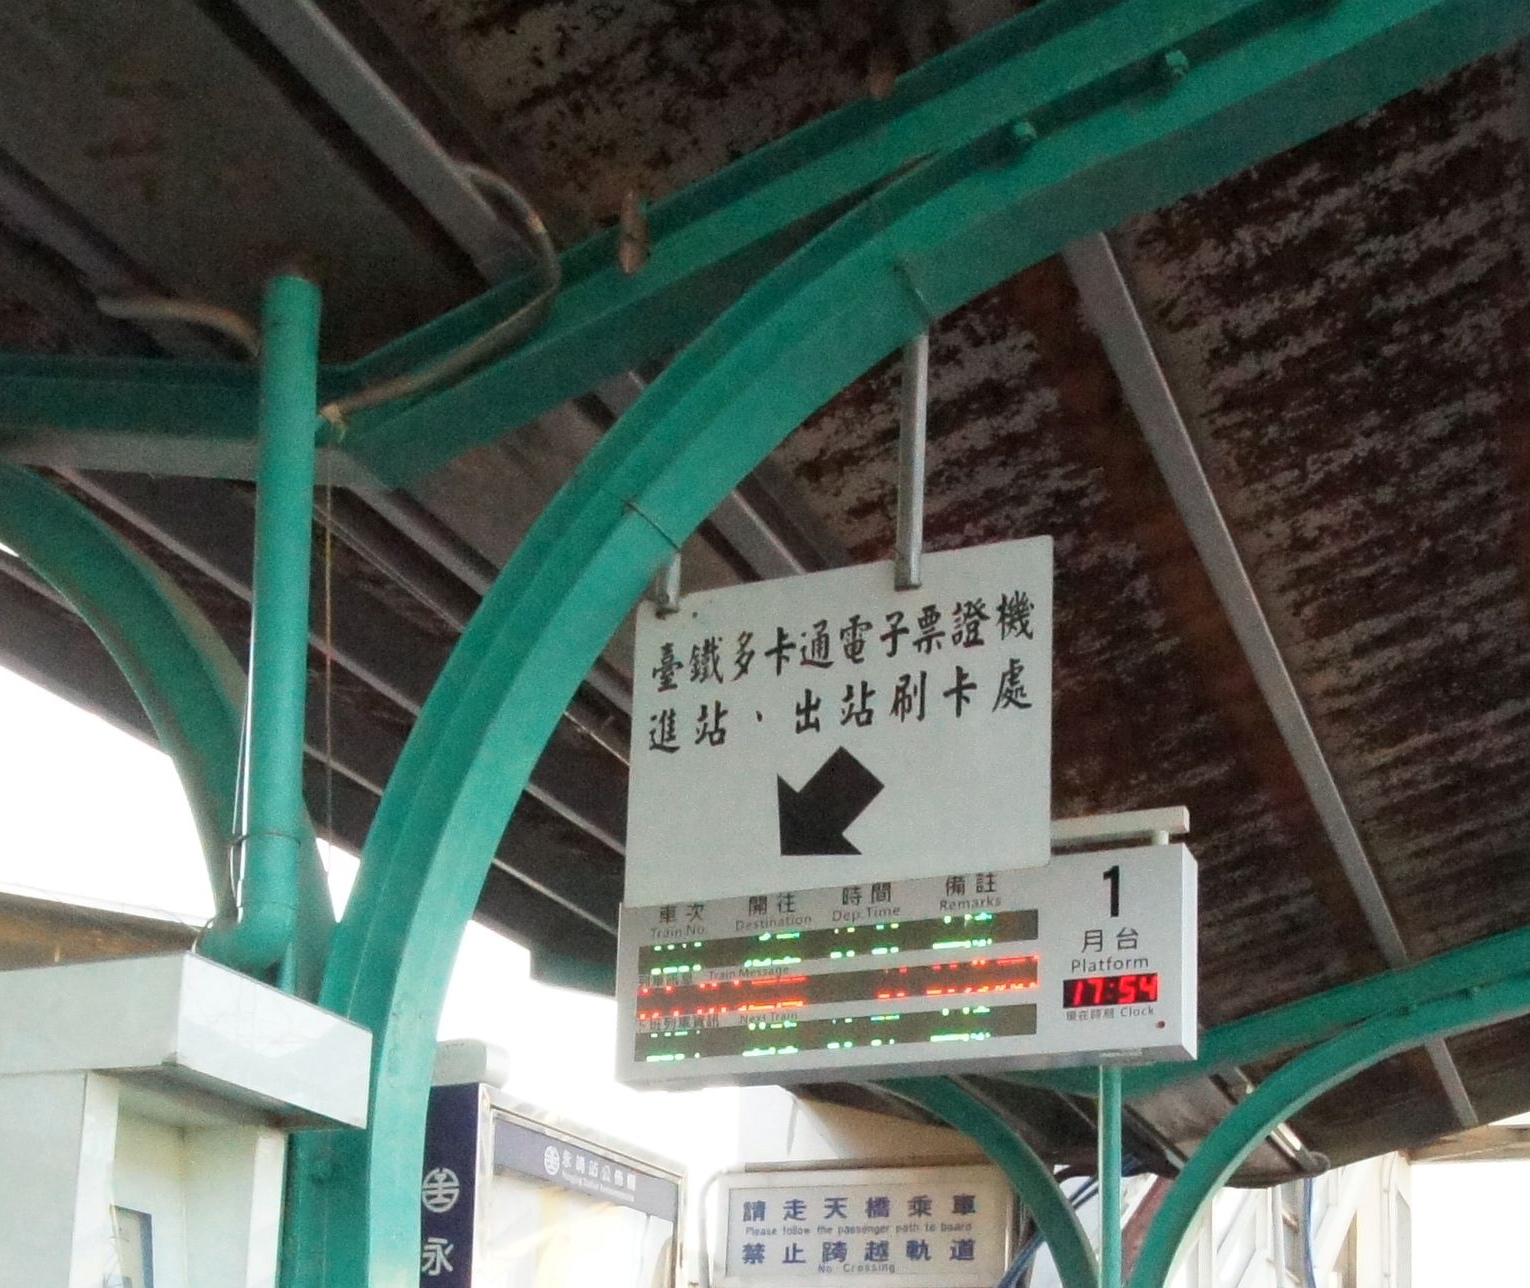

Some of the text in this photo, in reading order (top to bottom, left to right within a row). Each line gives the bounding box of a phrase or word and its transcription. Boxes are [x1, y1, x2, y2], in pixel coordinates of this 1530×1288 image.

[651, 590, 1035, 692] 臺鐵多卡通電子票證機
[649, 657, 1033, 753] 進站、出站刷卡處
[841, 881, 892, 907] 時間
[944, 872, 998, 896] 備註
[1102, 865, 1120, 917] 1
[659, 902, 706, 924] 車次
[748, 892, 797, 917] 開往
[867, 904, 901, 918] Time
[939, 895, 1001, 912] Remarks
[735, 915, 812, 931] Destination
[1081, 927, 1140, 953] 月台
[1071, 955, 1149, 973] Platform
[1072, 974, 1158, 1006] 17:54
[1120, 1005, 1155, 1017] Clock
[742, 1193, 977, 1222] 請走天橋乘車
[745, 1225, 777, 1236] Please
[817, 1223, 832, 1234] the
[837, 1224, 890, 1237] passenger
[895, 1222, 920, 1235] path
[925, 1222, 936, 1232] to
[940, 1221, 973, 1233] board
[741, 1238, 976, 1265] 禁止跨越軌道
[818, 1263, 896, 1274] No Crossing
